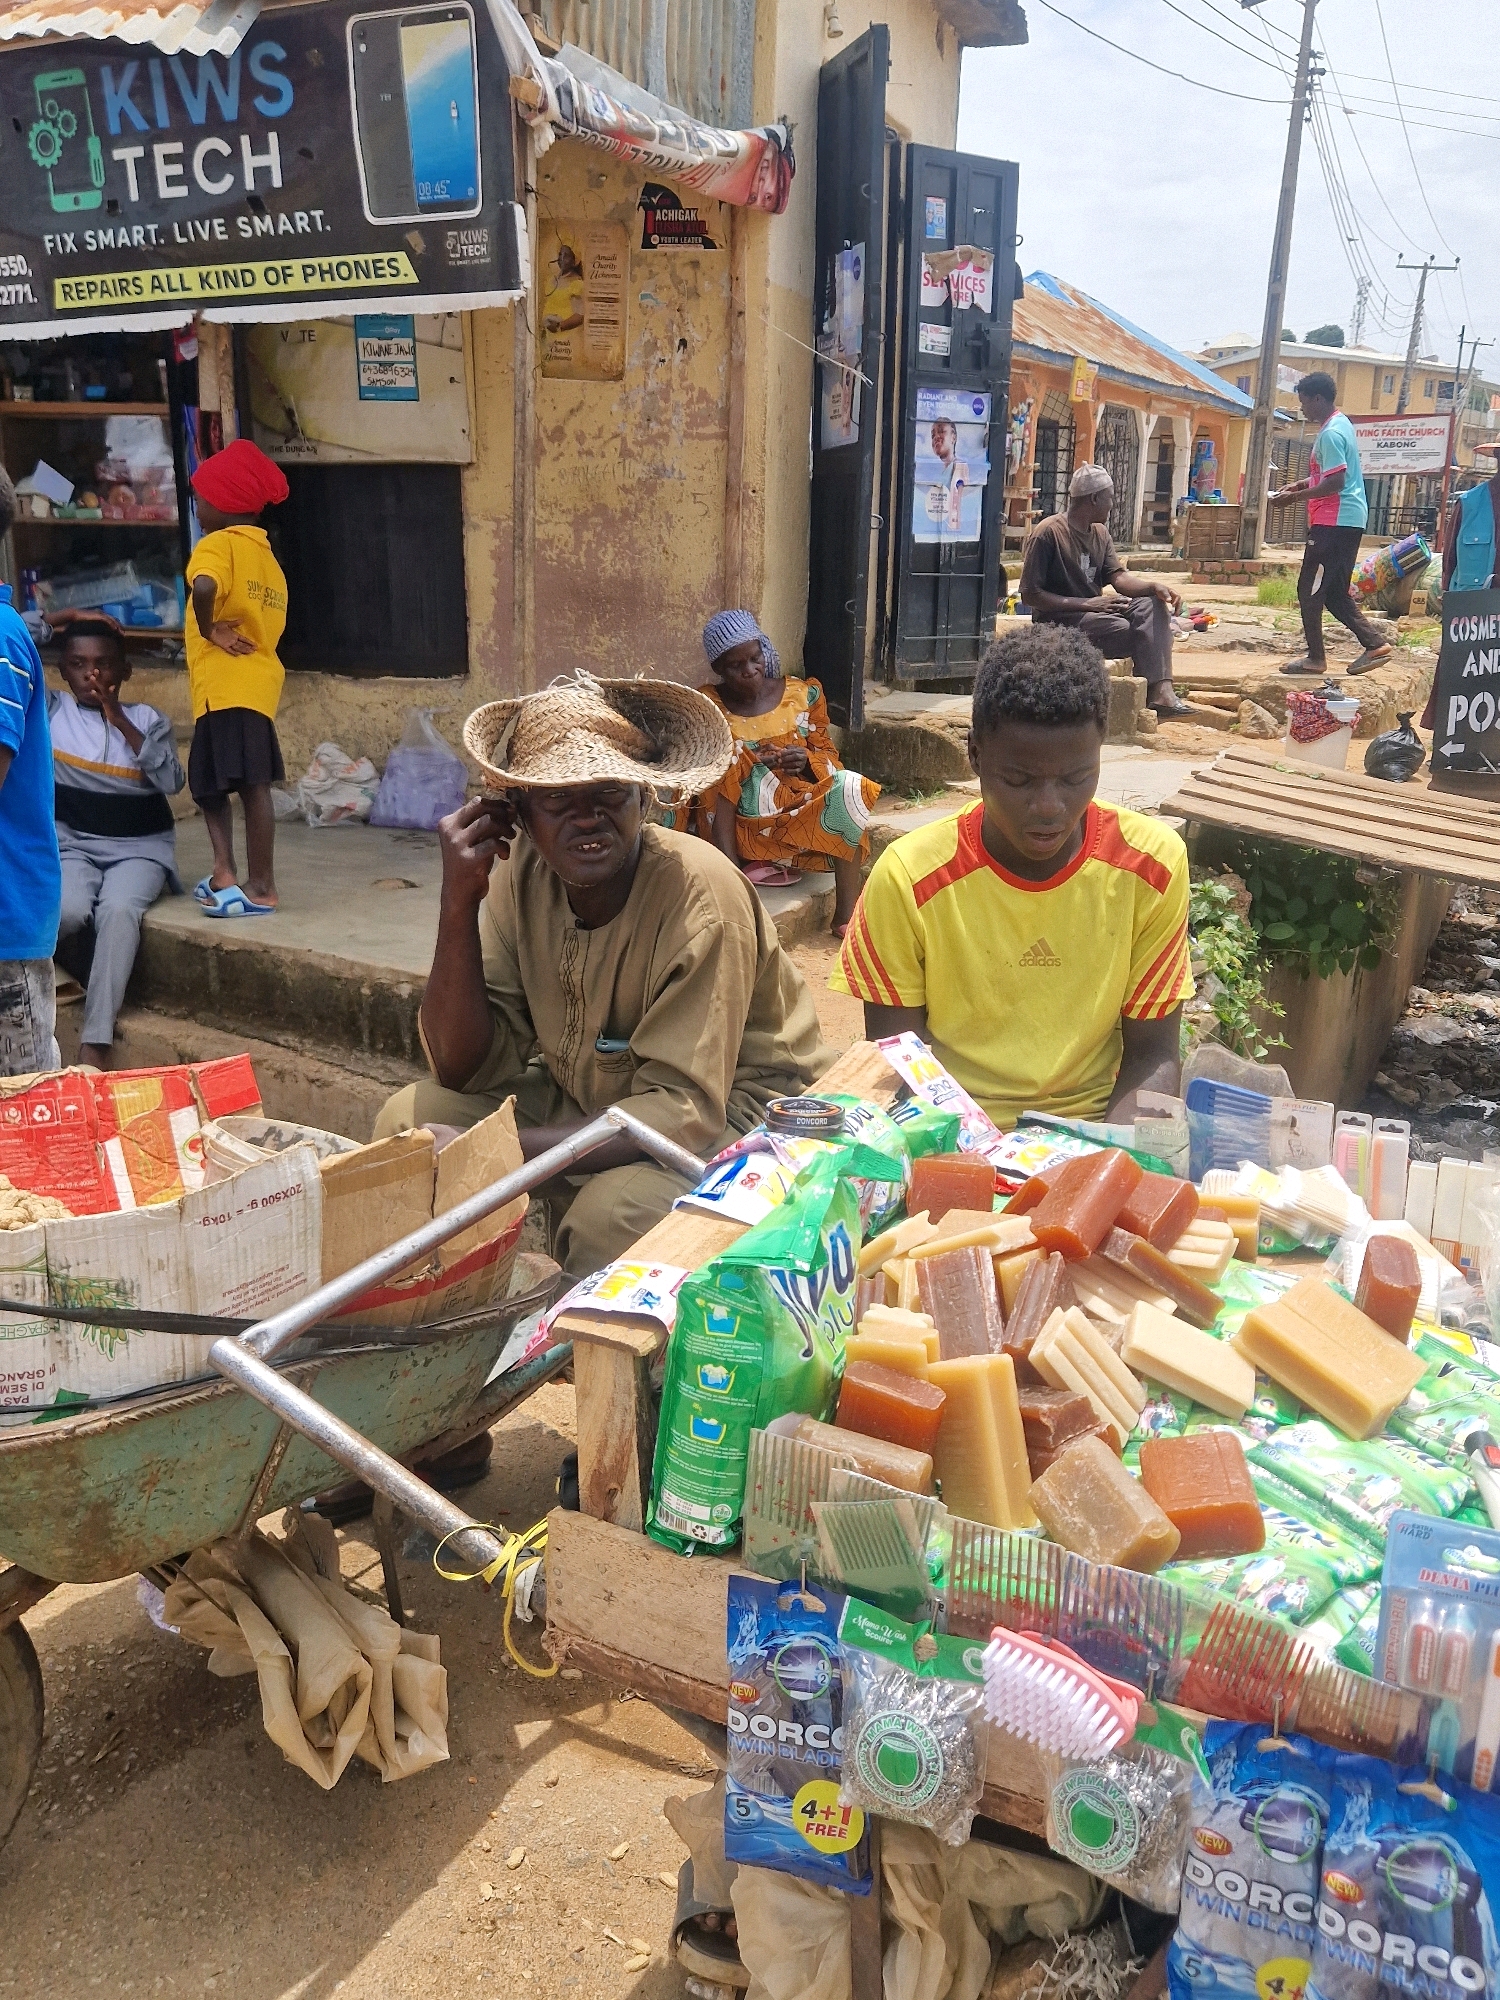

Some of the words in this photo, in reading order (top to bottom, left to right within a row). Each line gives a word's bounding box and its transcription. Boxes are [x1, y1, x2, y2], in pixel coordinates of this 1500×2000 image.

[101, 40, 294, 136] KIWS
[112, 131, 283, 202] TECH
[44, 231, 78, 255] FIX
[84, 223, 165, 251] SMART.
[173, 217, 228, 244] LIVE
[236, 209, 331, 239] SMART.
[460, 229, 488, 244] KIWS
[660, 236, 679, 244] YOUTH
[461, 245, 487, 257] TECH
[0, 254, 33, 278] 550,
[62, 276, 145, 302] REPAIRS
[150, 271, 192, 295] ALL
[198, 266, 257, 292] KIND
[264, 266, 294, 287] OF
[302, 257, 409, 284] PHONES.
[0, 283, 38, 306] 2771.
[281, 329, 316, 342] VTE
[1356, 429, 1380, 437] IVING
[1382, 428, 1406, 437] FAITH
[1408, 427, 1446, 436] CHURCH
[1376, 441, 1417, 449] KABONG
[1018, 955, 1061, 967] adidas
[796, 1116, 828, 1126] CONCORD
[261, 1183, 303, 1208] 20X500
[823, 1296, 856, 1354] plu
[32, 1382, 45, 1392] DI
[0, 1394, 30, 1406] PAS
[1401, 1528, 1431, 1540] HARD
[1412, 1523, 1433, 1532] EXTRA
[1419, 1568, 1470, 1591] DENTA
[852, 1615, 880, 1631] Mama
[880, 1625, 907, 1642] Wash
[864, 1628, 894, 1645] Scourer
[731, 1685, 756, 1698] NEW!
[728, 1731, 775, 1756] TWIN
[865, 1716, 902, 1742] MAMA
[904, 1720, 937, 1760] WASH
[736, 1797, 751, 1817] 5
[801, 1799, 852, 1826] 4+1
[1065, 1775, 1105, 1793] MAMA
[1107, 1785, 1135, 1831] WASH
[805, 1822, 848, 1839] FREE
[1195, 1831, 1227, 1850] NEW!
[1094, 1845, 1131, 1867] SCOURER
[1184, 1852, 1317, 1924] DORC
[1327, 1874, 1359, 1900] NEW!
[1185, 1881, 1242, 1923] TWIN
[1318, 1901, 1486, 1992] DORCO
[1184, 1955, 1202, 1978] 5
